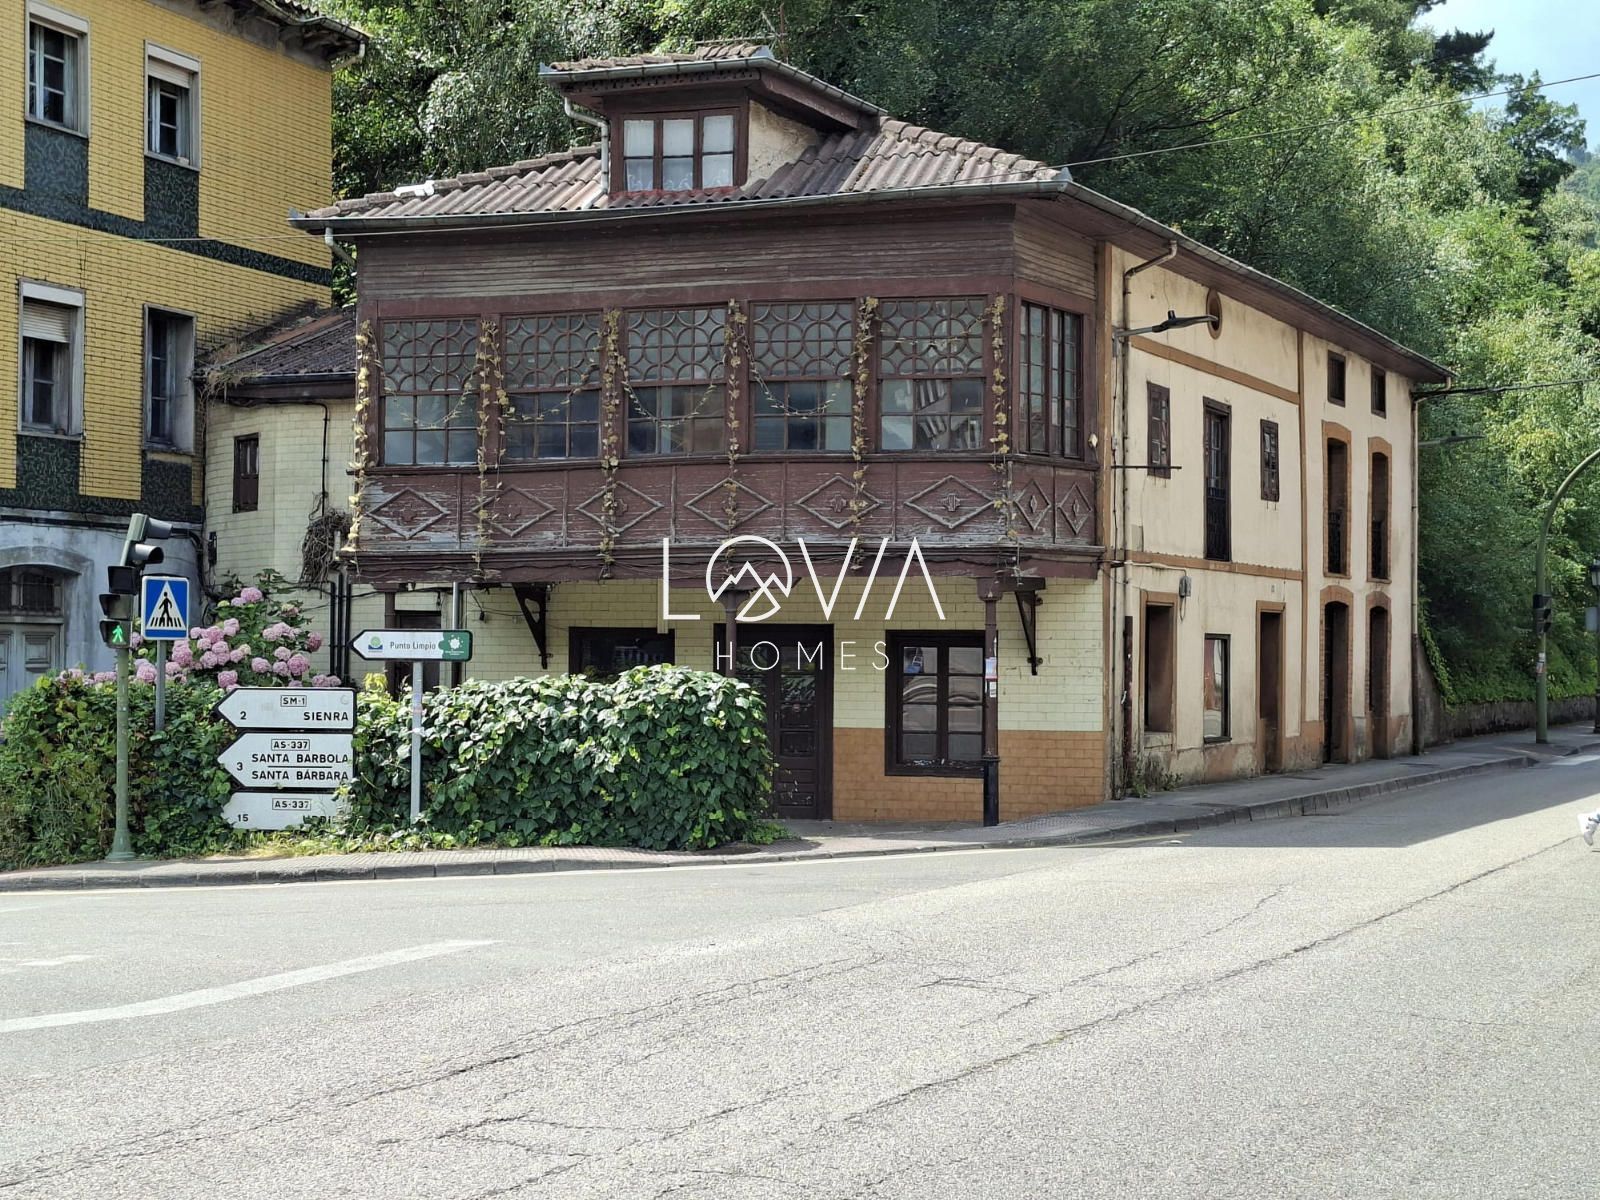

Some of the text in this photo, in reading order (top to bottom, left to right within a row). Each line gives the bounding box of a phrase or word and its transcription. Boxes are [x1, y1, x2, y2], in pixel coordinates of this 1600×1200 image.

[389, 641, 437, 651] Punto Limpio
[282, 697, 305, 705] SM-1
[240, 711, 349, 721] 2 SIENRA
[273, 741, 309, 749] AS-337
[251, 753, 349, 764] SANTA BARBOLA
[236, 762, 243, 771] 3
[251, 769, 349, 780] SANTA BÁRBARA
[274, 800, 310, 809] AS-337
[237, 813, 249, 822] 15
